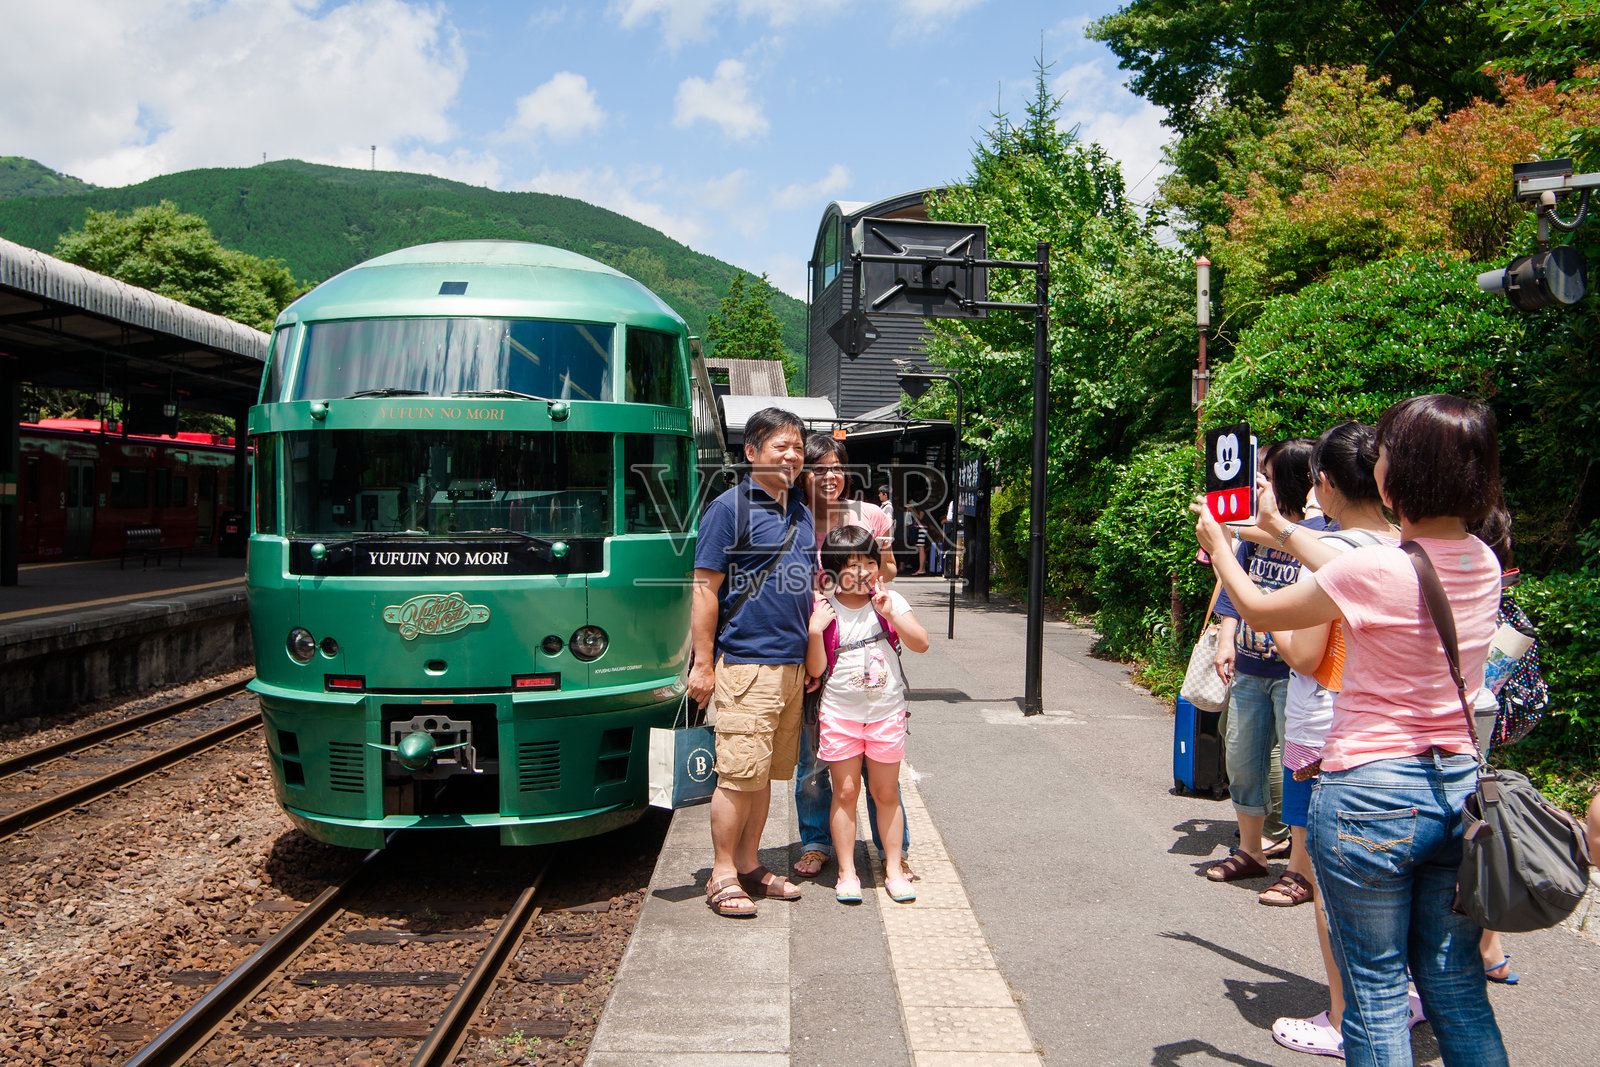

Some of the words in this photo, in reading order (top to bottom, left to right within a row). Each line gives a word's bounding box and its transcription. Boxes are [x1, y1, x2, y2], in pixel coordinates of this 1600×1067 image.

[380, 407, 435, 420] YUFUIN
[440, 407, 462, 420] NO
[465, 408, 505, 421] MORI
[368, 551, 430, 566] YUFUIN
[434, 551, 461, 566] NO
[463, 551, 509, 566] MORI
[695, 756, 707, 773] B
